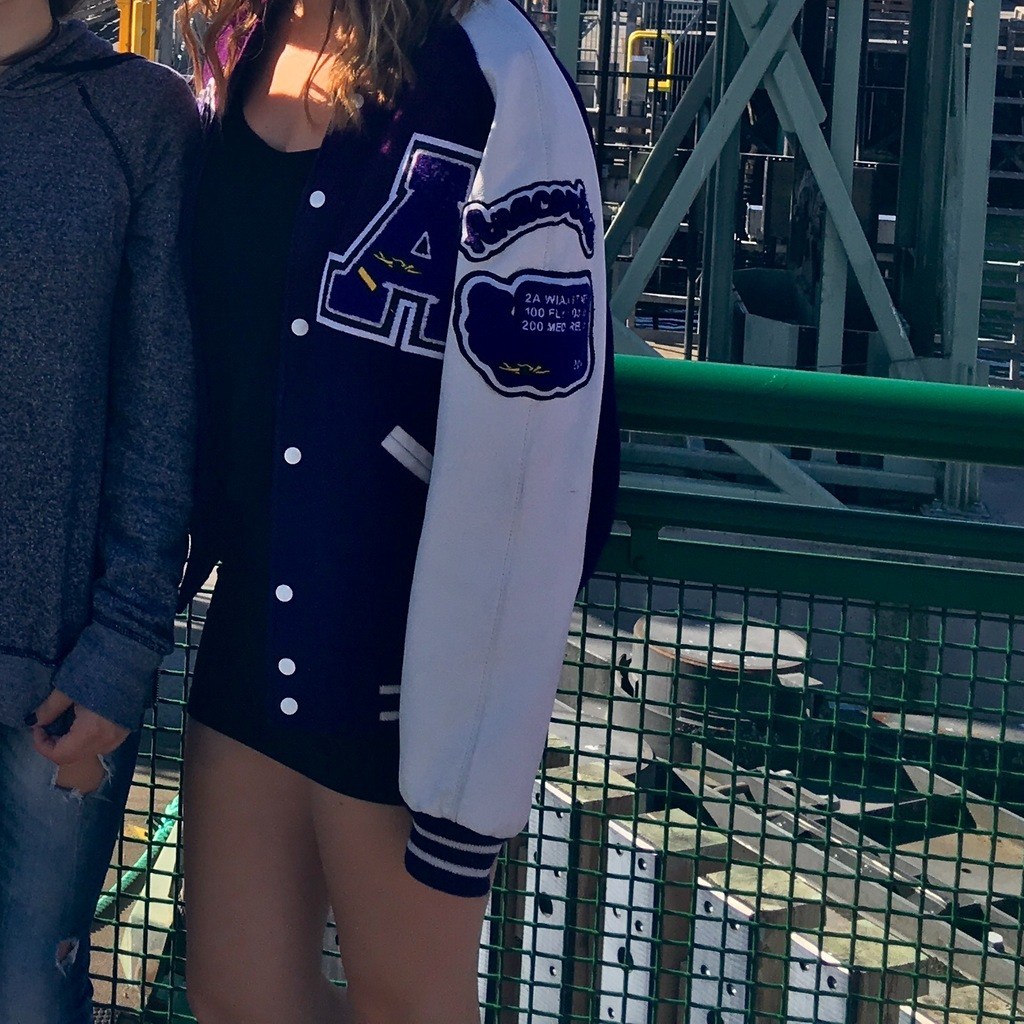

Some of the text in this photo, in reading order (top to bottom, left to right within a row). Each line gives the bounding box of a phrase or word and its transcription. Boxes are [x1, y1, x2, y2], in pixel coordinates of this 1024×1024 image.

[525, 293, 541, 304] 2A
[525, 307, 545, 318] 100
[522, 320, 544, 332] 200
